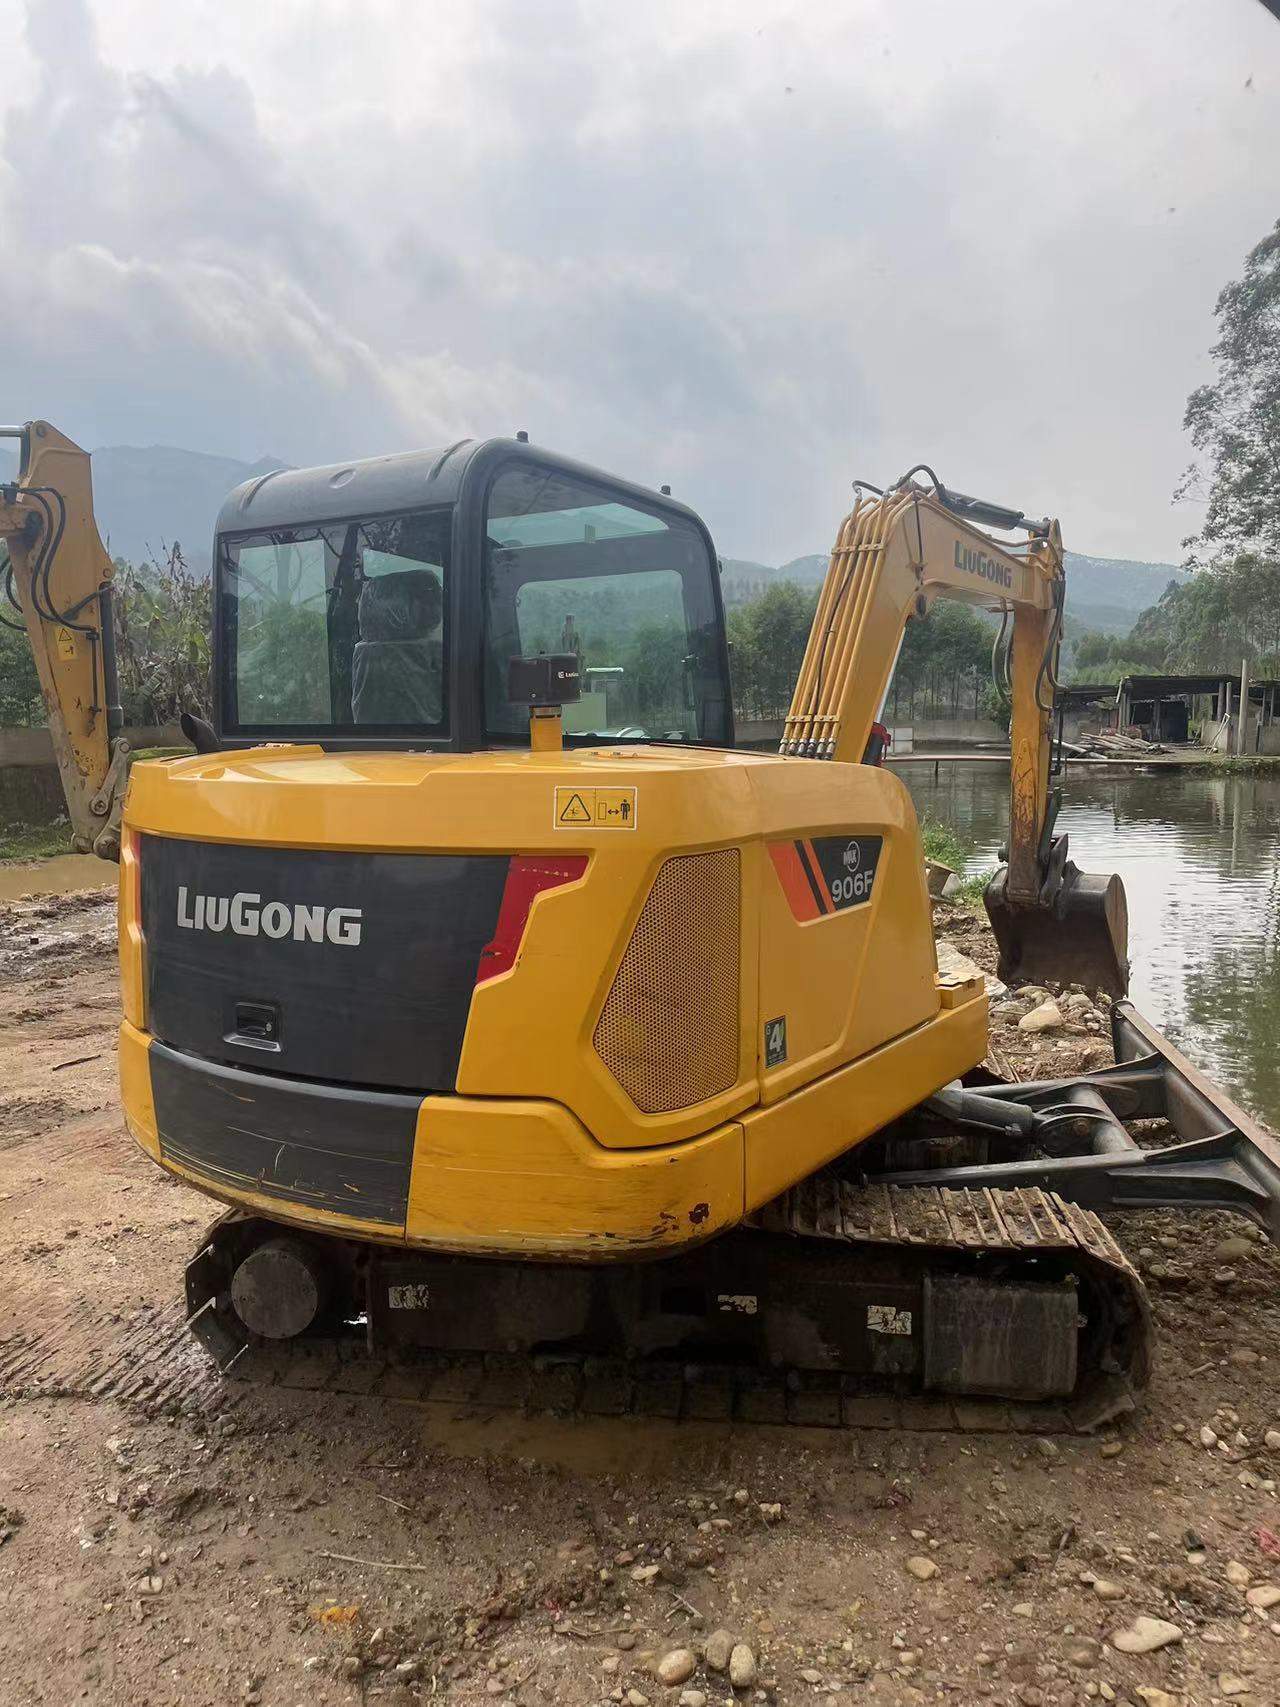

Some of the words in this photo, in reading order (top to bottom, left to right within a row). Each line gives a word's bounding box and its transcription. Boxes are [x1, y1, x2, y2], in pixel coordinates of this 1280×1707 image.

[954, 540, 1012, 588] LIUGONG
[831, 869, 873, 902] 906F
[177, 886, 362, 946] LIUGONG
